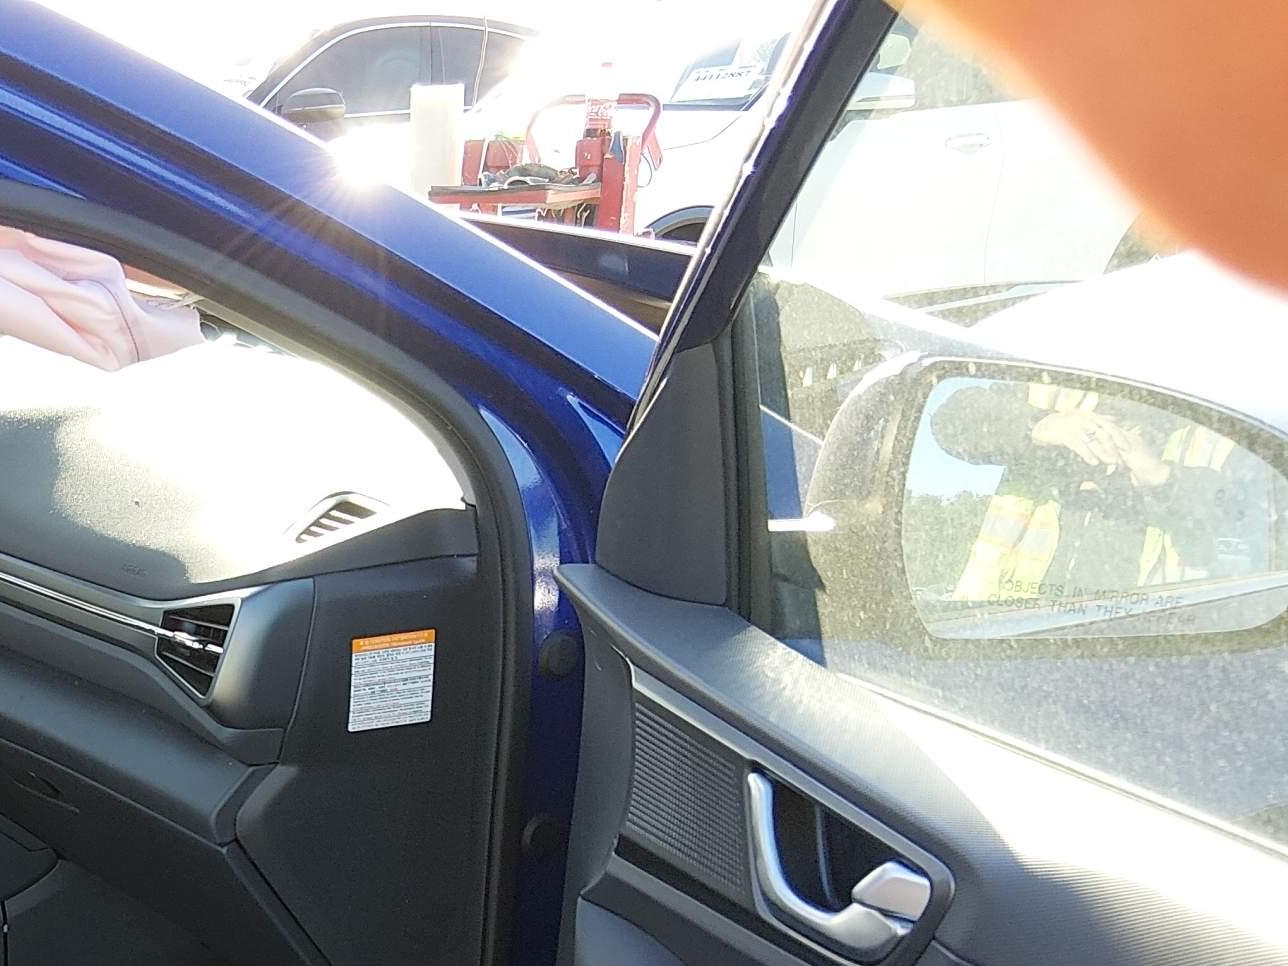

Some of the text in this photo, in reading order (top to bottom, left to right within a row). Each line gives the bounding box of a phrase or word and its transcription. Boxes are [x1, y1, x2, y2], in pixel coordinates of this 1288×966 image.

[1005, 579, 1065, 598] OBJECTS
[987, 593, 1041, 610] CLOSER
[1049, 599, 1088, 616] THAN
[1095, 604, 1134, 617] THEY
